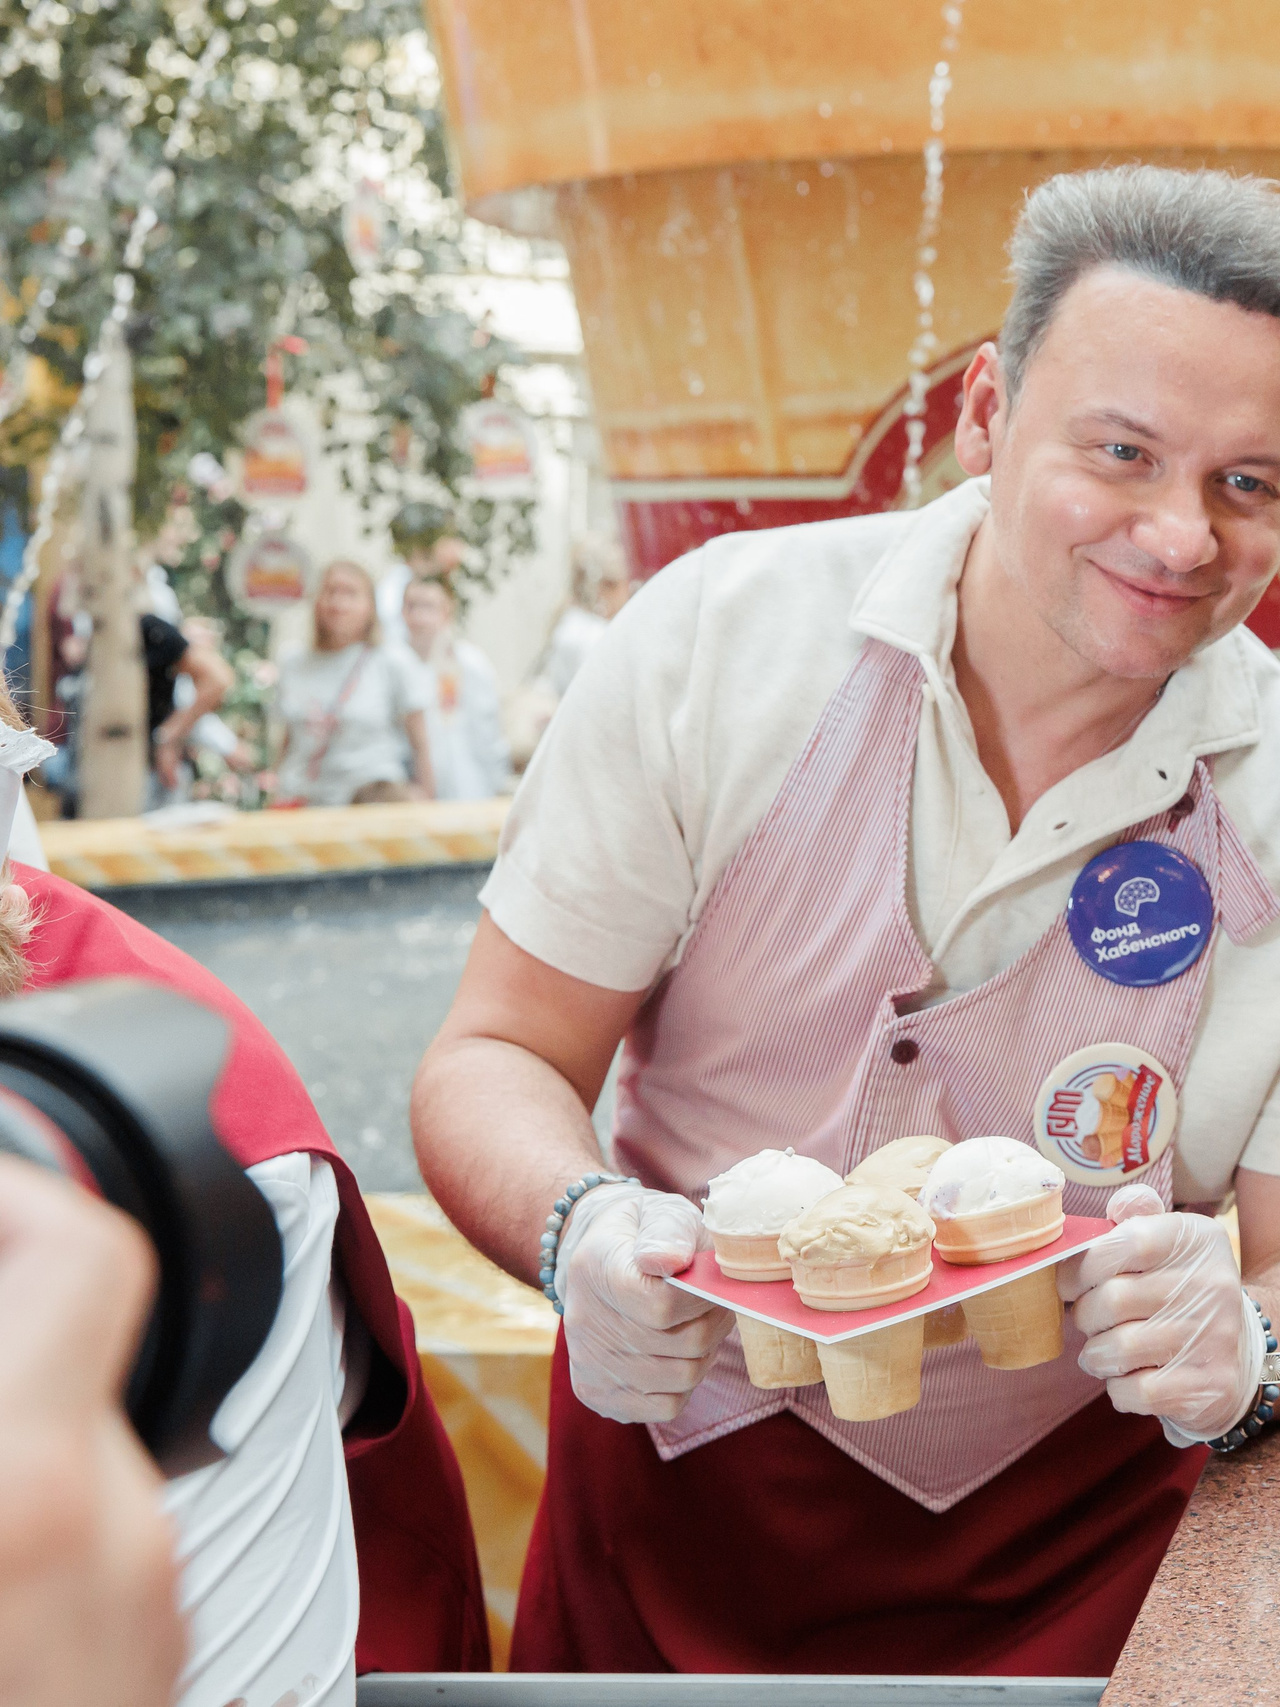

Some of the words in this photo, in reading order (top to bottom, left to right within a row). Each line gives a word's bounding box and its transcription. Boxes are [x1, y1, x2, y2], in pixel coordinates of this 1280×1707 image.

[1090, 921, 1141, 944] Фонд
[1094, 922, 1201, 963] Хабенского
[1126, 1073, 1157, 1165] Мороженое
